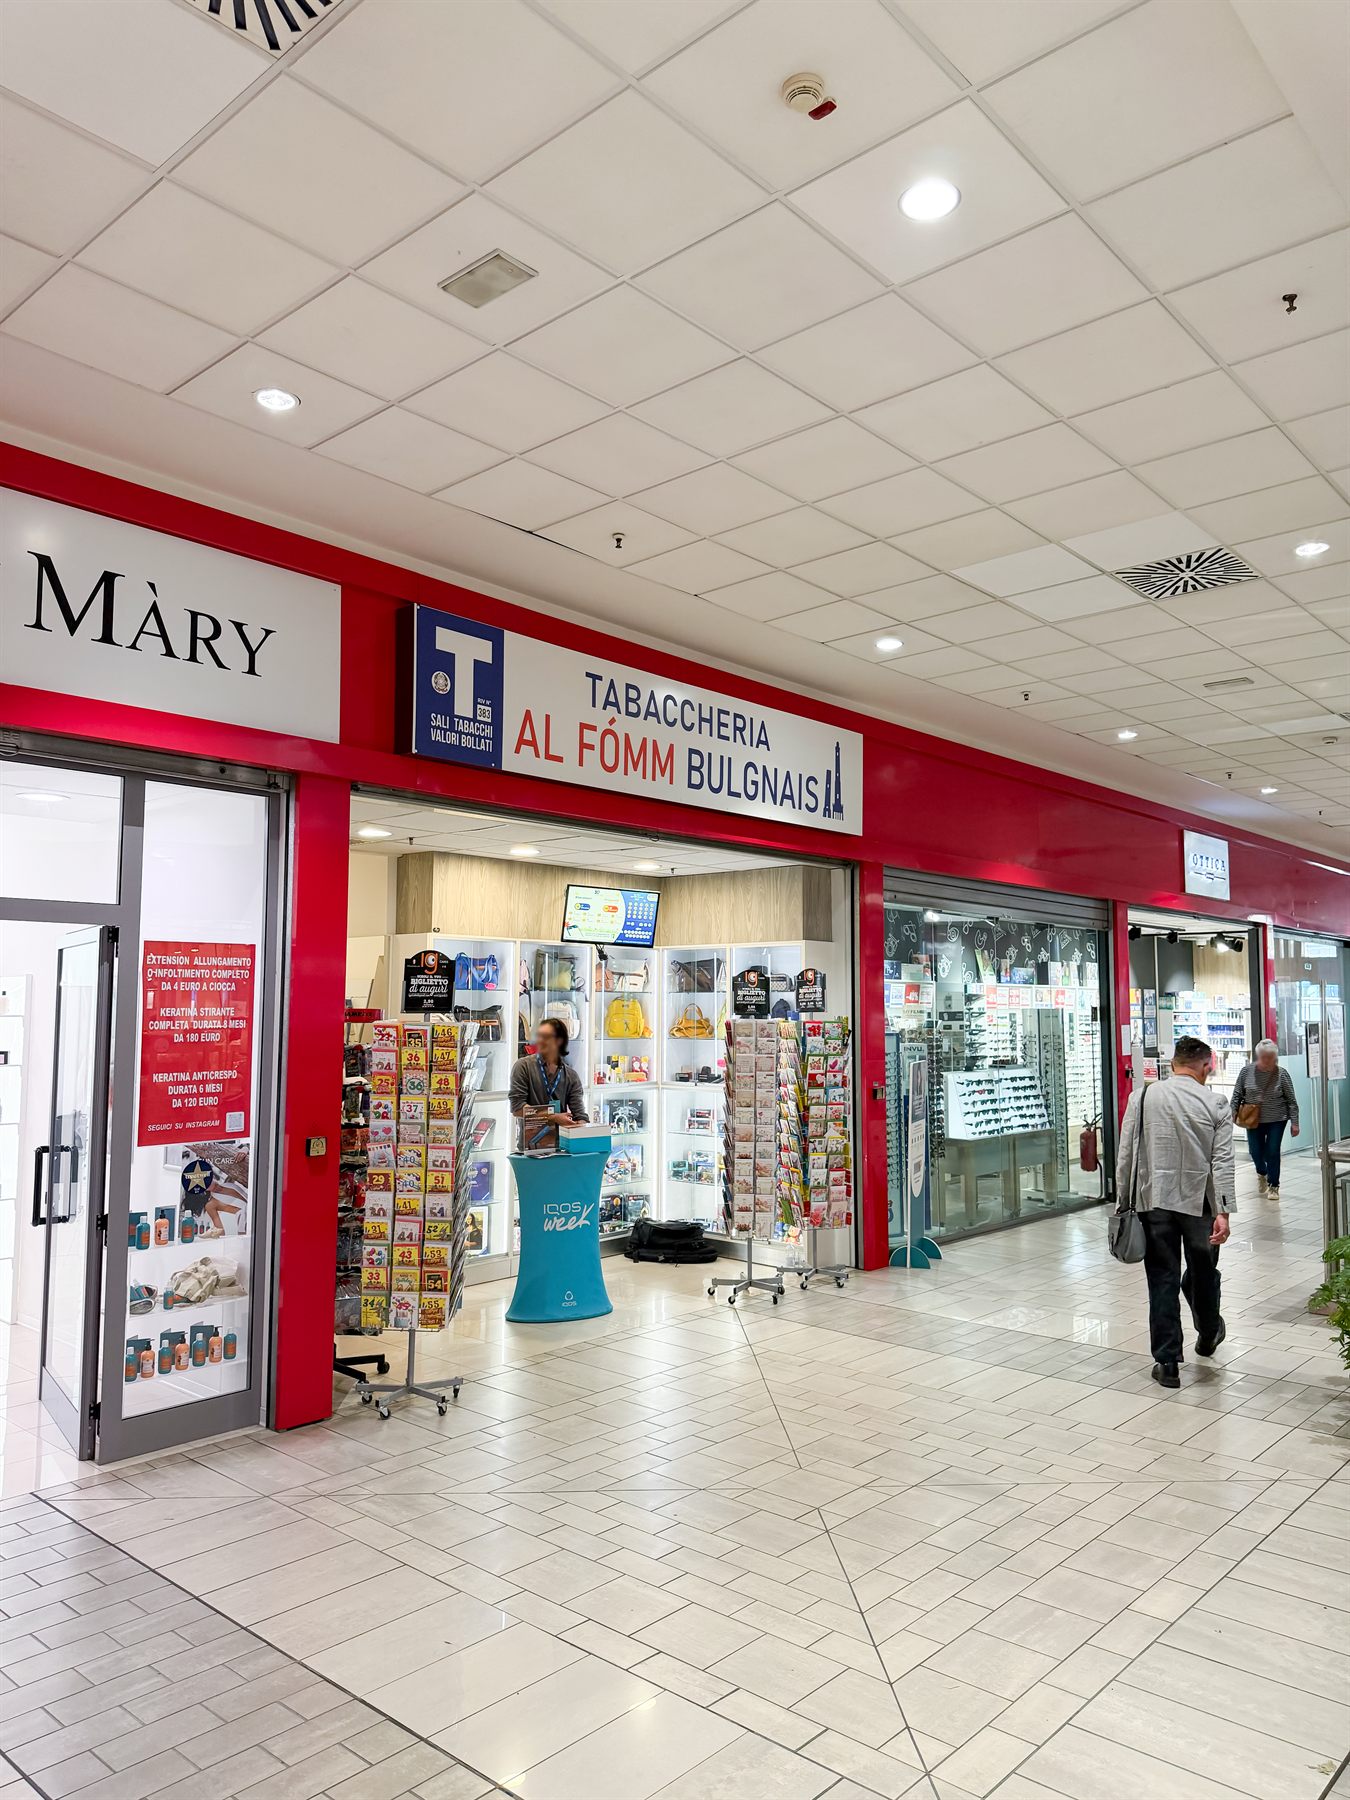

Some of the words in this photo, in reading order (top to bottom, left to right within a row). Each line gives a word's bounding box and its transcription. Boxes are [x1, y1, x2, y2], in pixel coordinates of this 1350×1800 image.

[24, 549, 277, 678] MÀRY
[435, 625, 493, 719] T
[478, 707, 491, 719] 383
[585, 671, 771, 752] TABACCHERIA
[430, 712, 450, 729] SALI
[453, 717, 493, 739] TABACCHI
[430, 727, 459, 746] VALORI
[461, 734, 493, 753] BOLLATI
[513, 708, 564, 764] AL
[578, 716, 675, 786] FÓMM
[687, 747, 819, 814] BULGNAIS
[1192, 853, 1226, 872] OTTICA
[146, 954, 190, 966] EXTENSION
[193, 955, 251, 967] ALLUNGAMENTO
[154, 968, 210, 979] INFOLTIMENTO
[211, 969, 250, 979] COMPLETO
[161, 982, 172, 991] DA
[173, 982, 179, 991] 4
[180, 981, 201, 991] EURO
[202, 982, 208, 991] A
[209, 981, 236, 991] CIOCCA
[160, 1007, 198, 1017] KERATINA
[199, 1007, 235, 1017] STIRANTE
[148, 1020, 189, 1030] COMPLETA
[192, 1019, 222, 1030] DURATA
[223, 1019, 228, 1029] 8
[228, 1019, 246, 1029] MESI
[442, 1028, 453, 1037] 46
[173, 1033, 184, 1043] DA
[186, 1033, 199, 1043] 180
[200, 1033, 221, 1042] EURO
[408, 1039, 422, 1048] 35
[406, 1053, 420, 1062] 36
[440, 1052, 450, 1061] 47
[152, 1071, 191, 1083] KERATINA
[192, 1069, 238, 1081] ANTICRESPO
[377, 1078, 390, 1086] 25
[408, 1081, 423, 1090] 36
[436, 1078, 450, 1087] 48
[168, 1084, 198, 1095] DURATA
[199, 1085, 204, 1094] 6
[205, 1083, 223, 1093] MESI
[172, 1098, 182, 1108] DA
[184, 1097, 197, 1108] 120
[198, 1096, 219, 1106] EURO
[436, 1100, 448, 1110] 49
[406, 1104, 418, 1113] 37
[147, 1123, 172, 1132] SEGUICI
[174, 1122, 184, 1130] SU
[185, 1119, 220, 1129] INSTAGRAM
[372, 1175, 385, 1185] 29
[434, 1176, 445, 1184] 51
[402, 1201, 412, 1209] 41
[543, 1201, 582, 1216] IQOS
[543, 1203, 595, 1232] week
[426, 1226, 438, 1234] 52
[398, 1250, 412, 1260] 43
[367, 1272, 380, 1281] 33
[428, 1280, 442, 1290] 54
[362, 1298, 374, 1308] 34
[428, 1300, 440, 1309] 55
